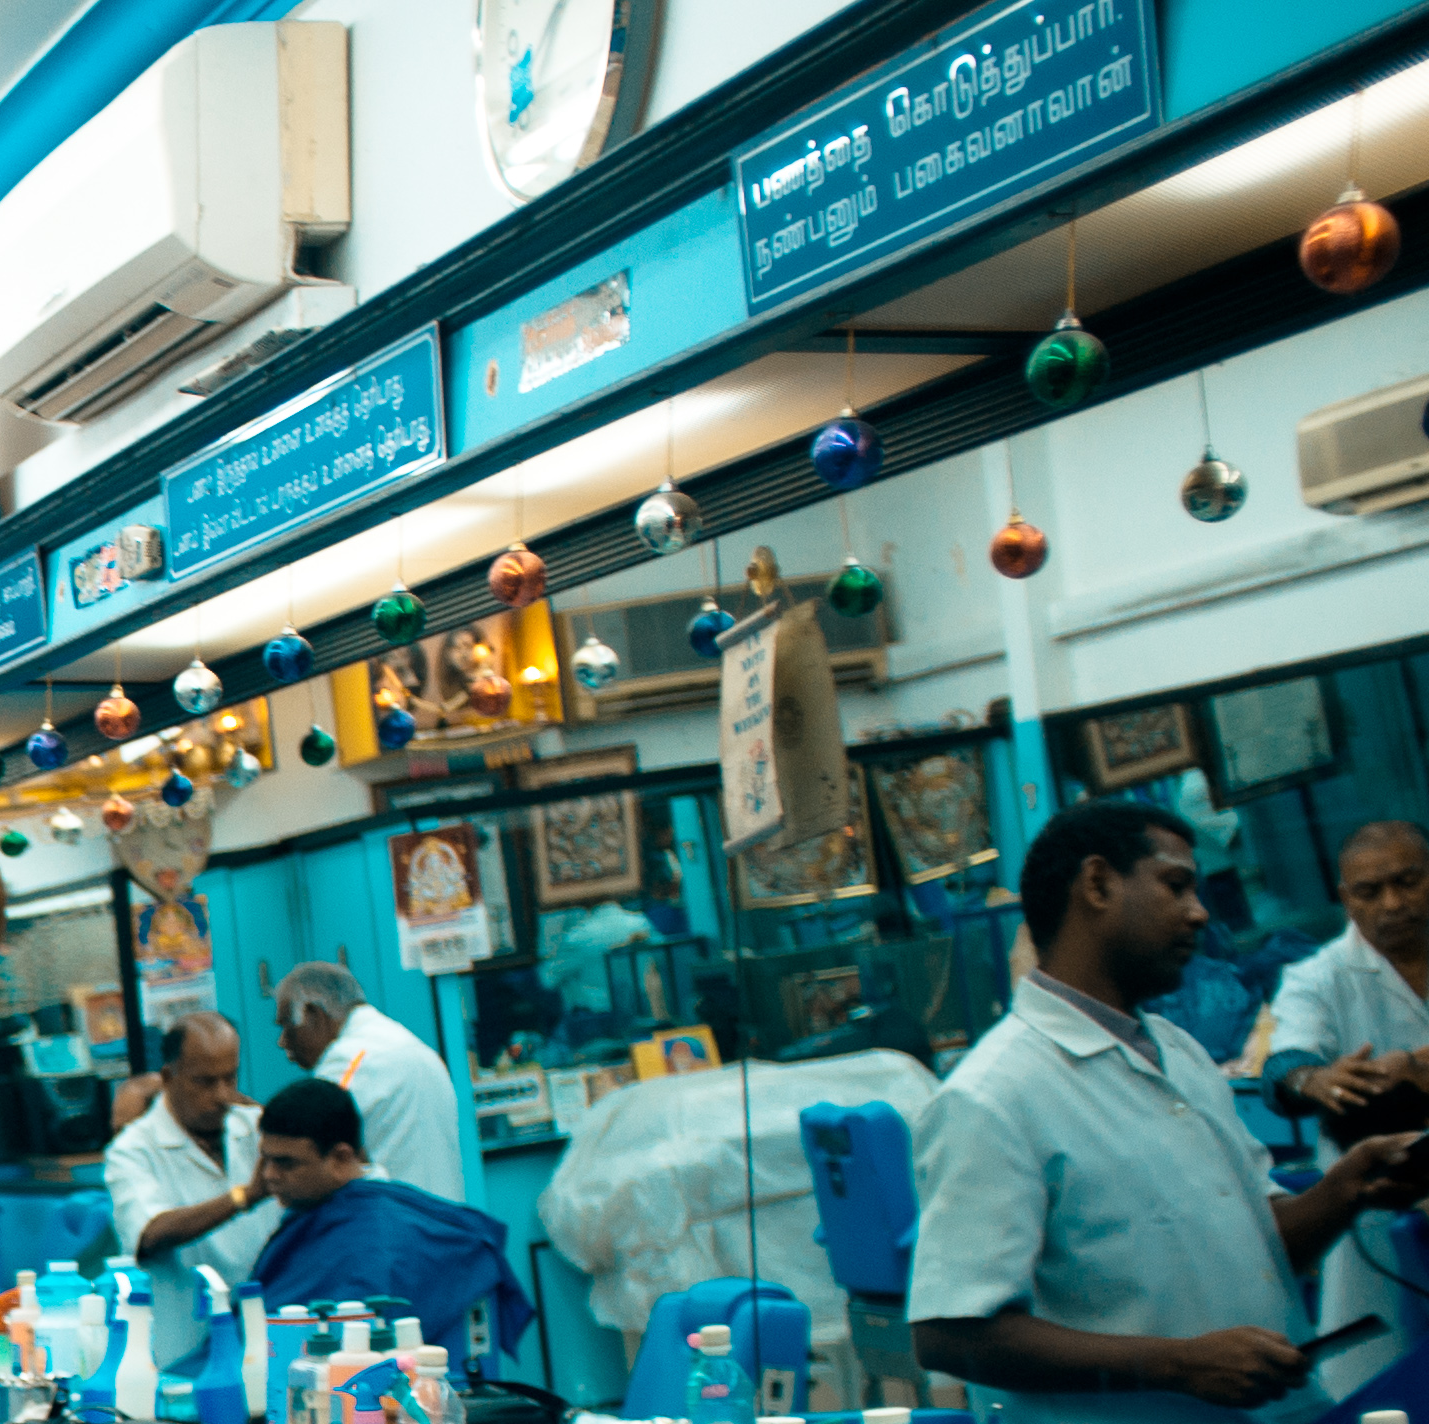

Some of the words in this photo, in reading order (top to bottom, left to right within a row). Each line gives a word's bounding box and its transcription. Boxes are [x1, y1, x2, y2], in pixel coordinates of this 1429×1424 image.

[752, 125, 872, 209] பணத்தை
[754, 174, 878, 280] நண்பனும்
[892, 45, 1133, 200] பகைவனாவான்
